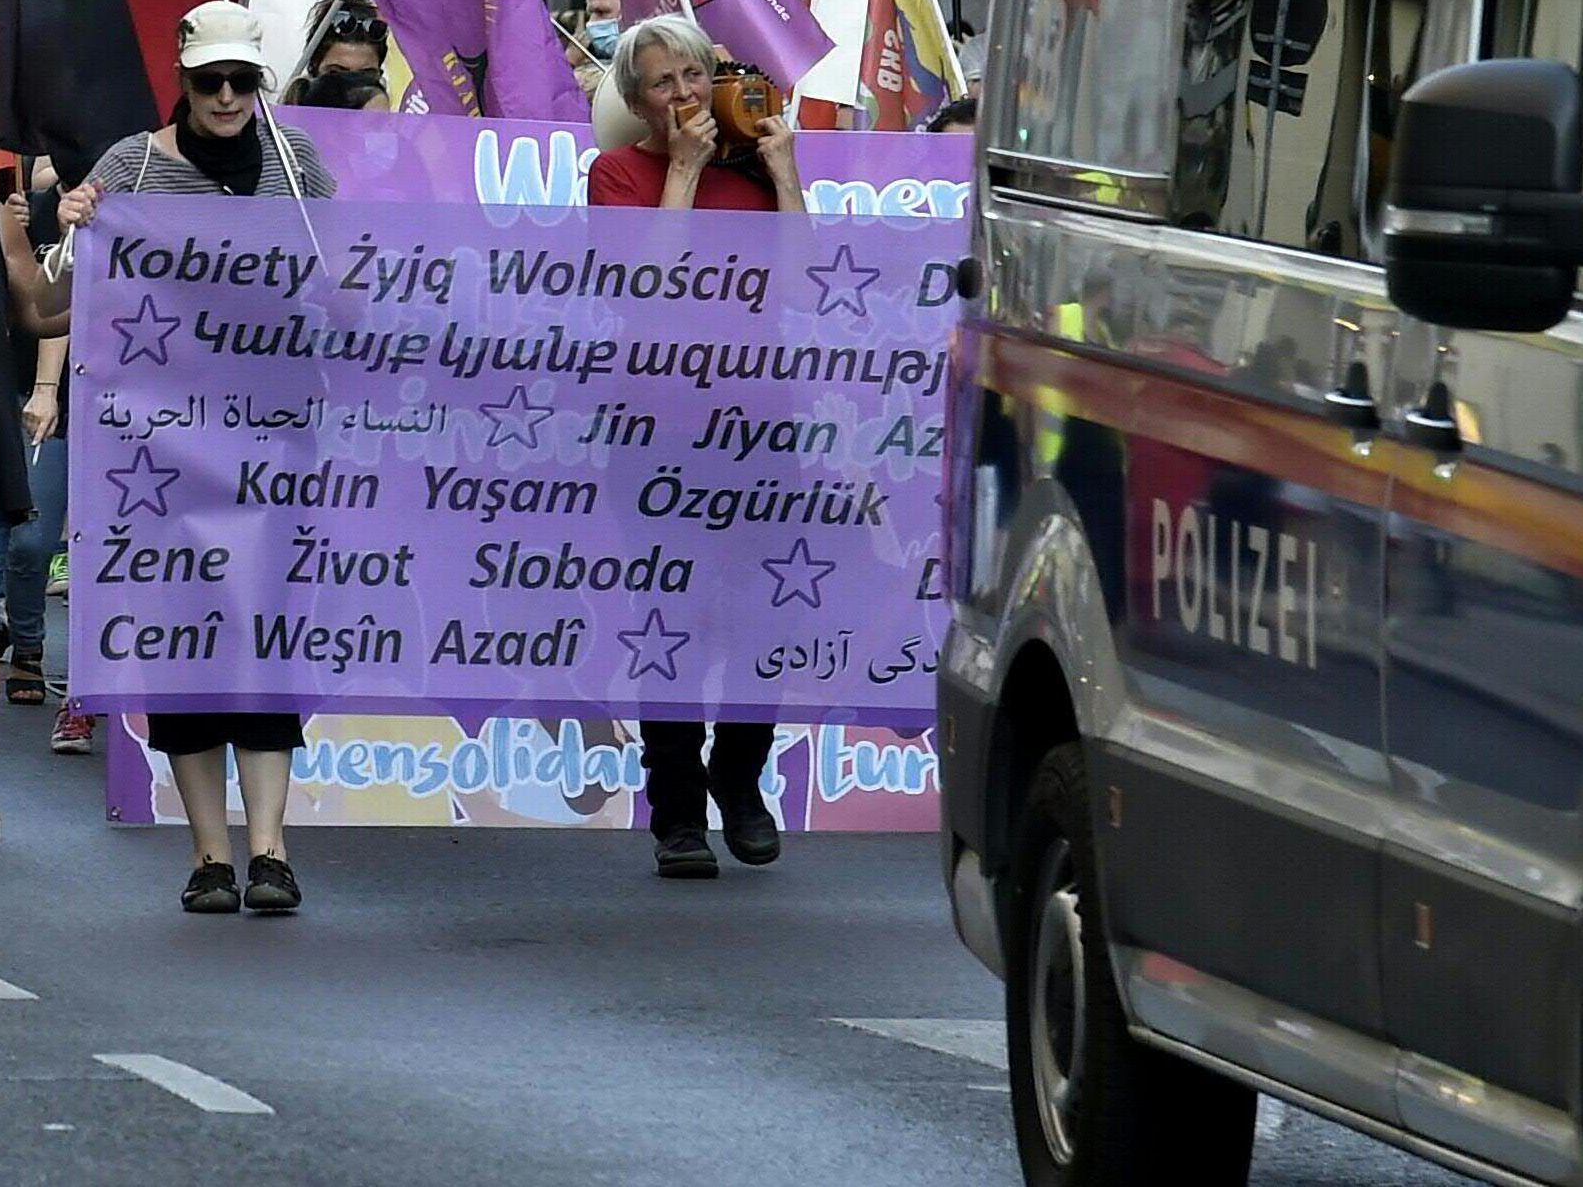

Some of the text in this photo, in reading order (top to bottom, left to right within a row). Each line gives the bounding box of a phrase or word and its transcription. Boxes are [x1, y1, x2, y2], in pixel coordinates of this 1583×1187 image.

[107, 235, 317, 299] Kobiety
[340, 233, 456, 304] Żyją
[488, 249, 771, 314] Wolnością
[97, 390, 206, 442] الحرية
[222, 392, 326, 442] الحياة
[576, 402, 657, 447] Jin
[691, 405, 838, 462] Jîyan
[235, 459, 890, 531] Kadın Yaşam Özgürlük
[95, 524, 695, 594] Žene Život Sloboda
[1151, 497, 1317, 670] POLIZEI
[98, 609, 586, 674] Cenî Weşîn Azadî
[754, 629, 854, 680] آزادی
